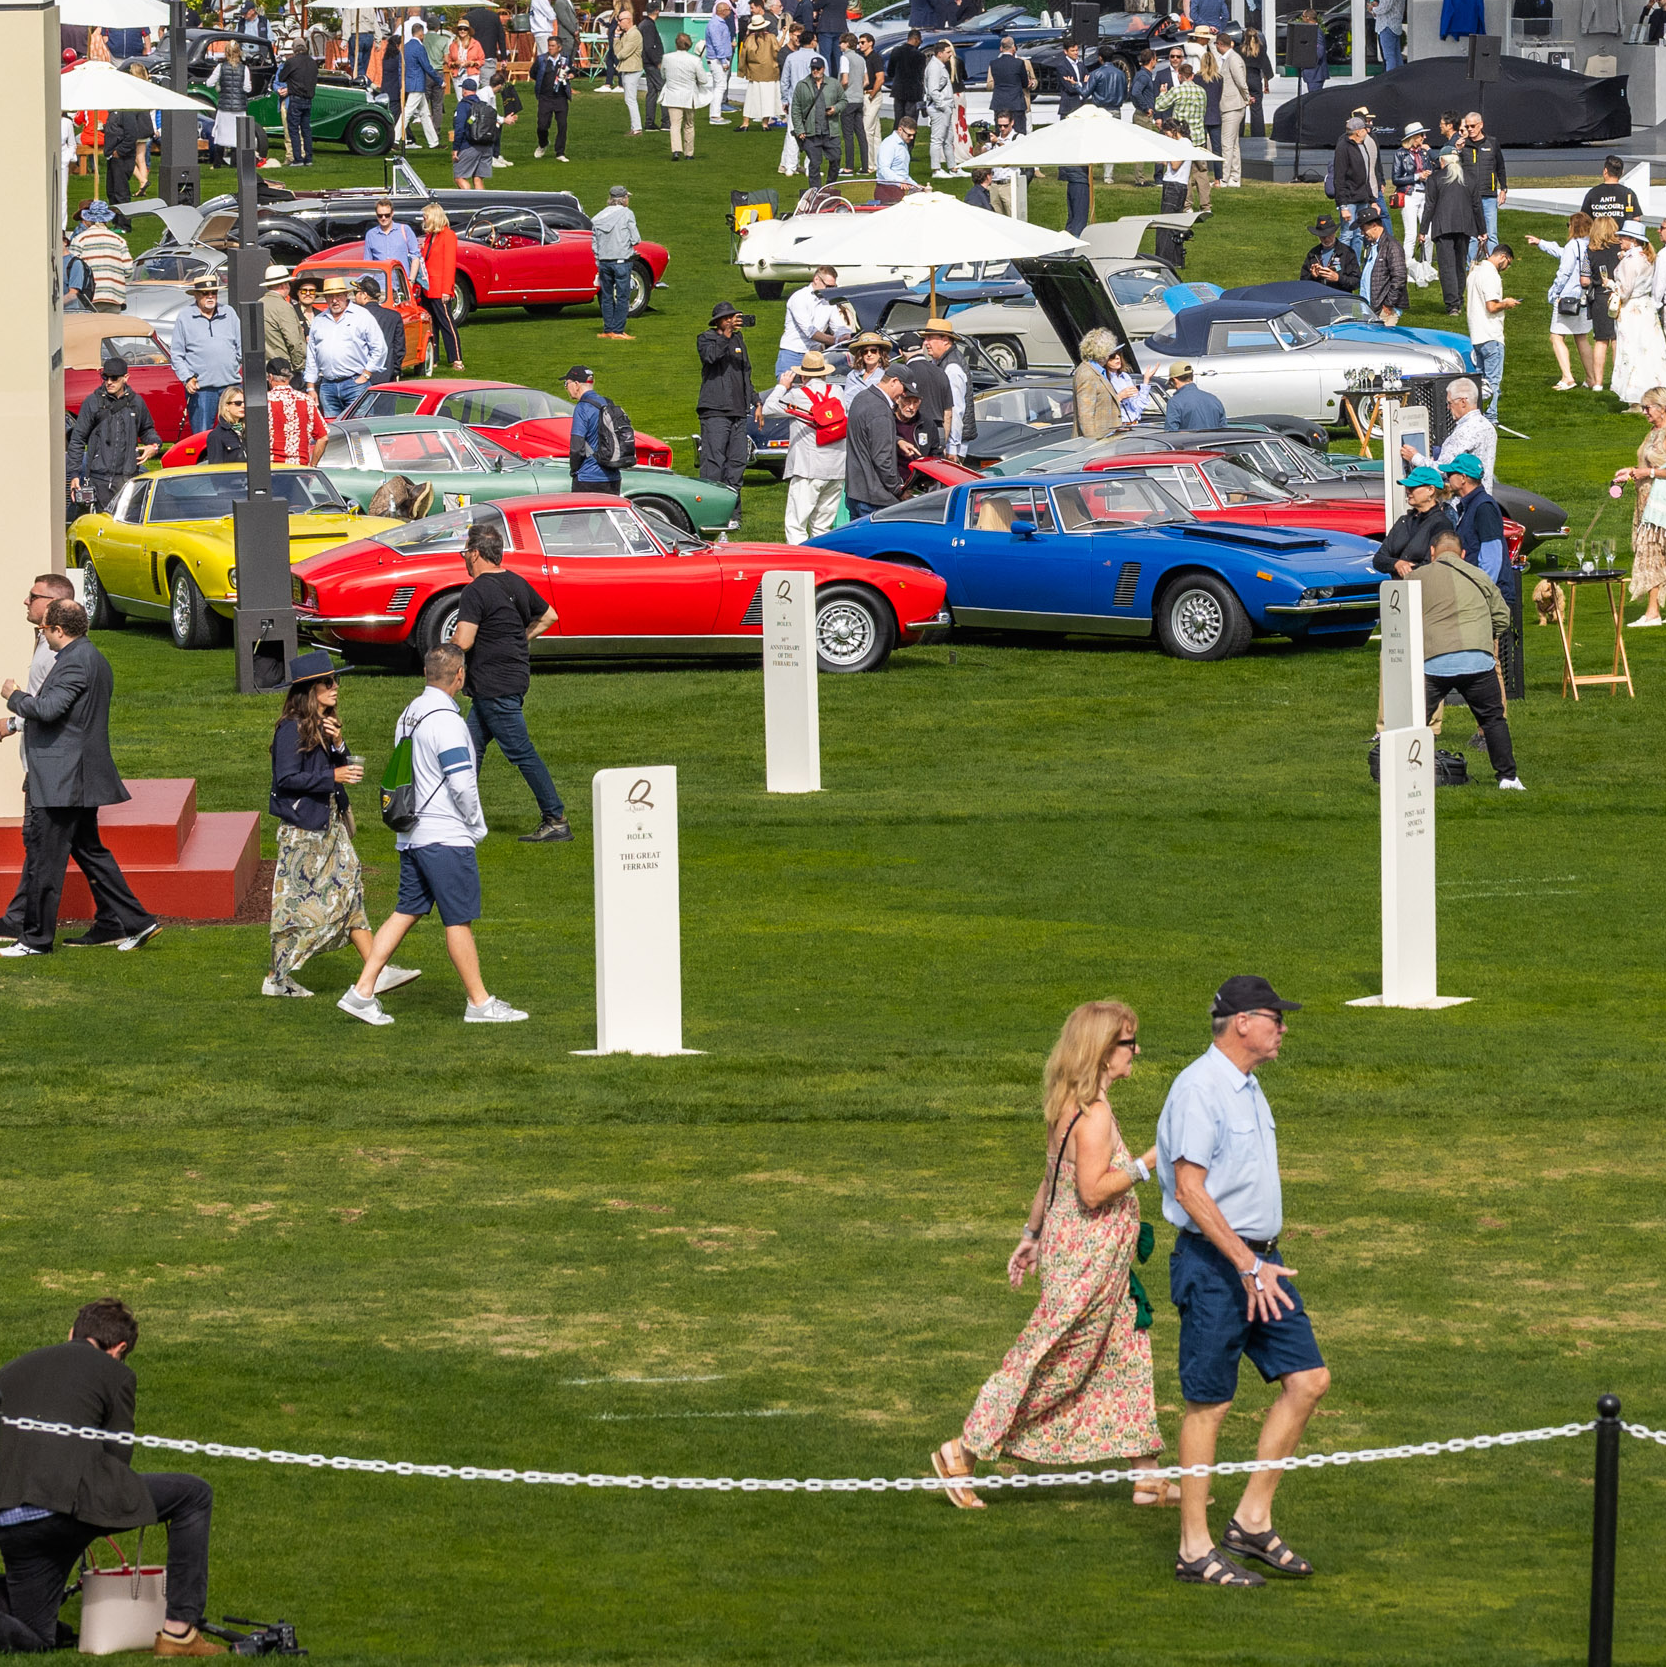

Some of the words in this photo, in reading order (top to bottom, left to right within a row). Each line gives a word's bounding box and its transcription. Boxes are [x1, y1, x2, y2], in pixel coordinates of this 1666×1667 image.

[626, 832, 653, 841] ROLEX
[619, 853, 635, 861] THE
[636, 851, 661, 860] GREAT
[622, 862, 659, 871] FERRARIS
